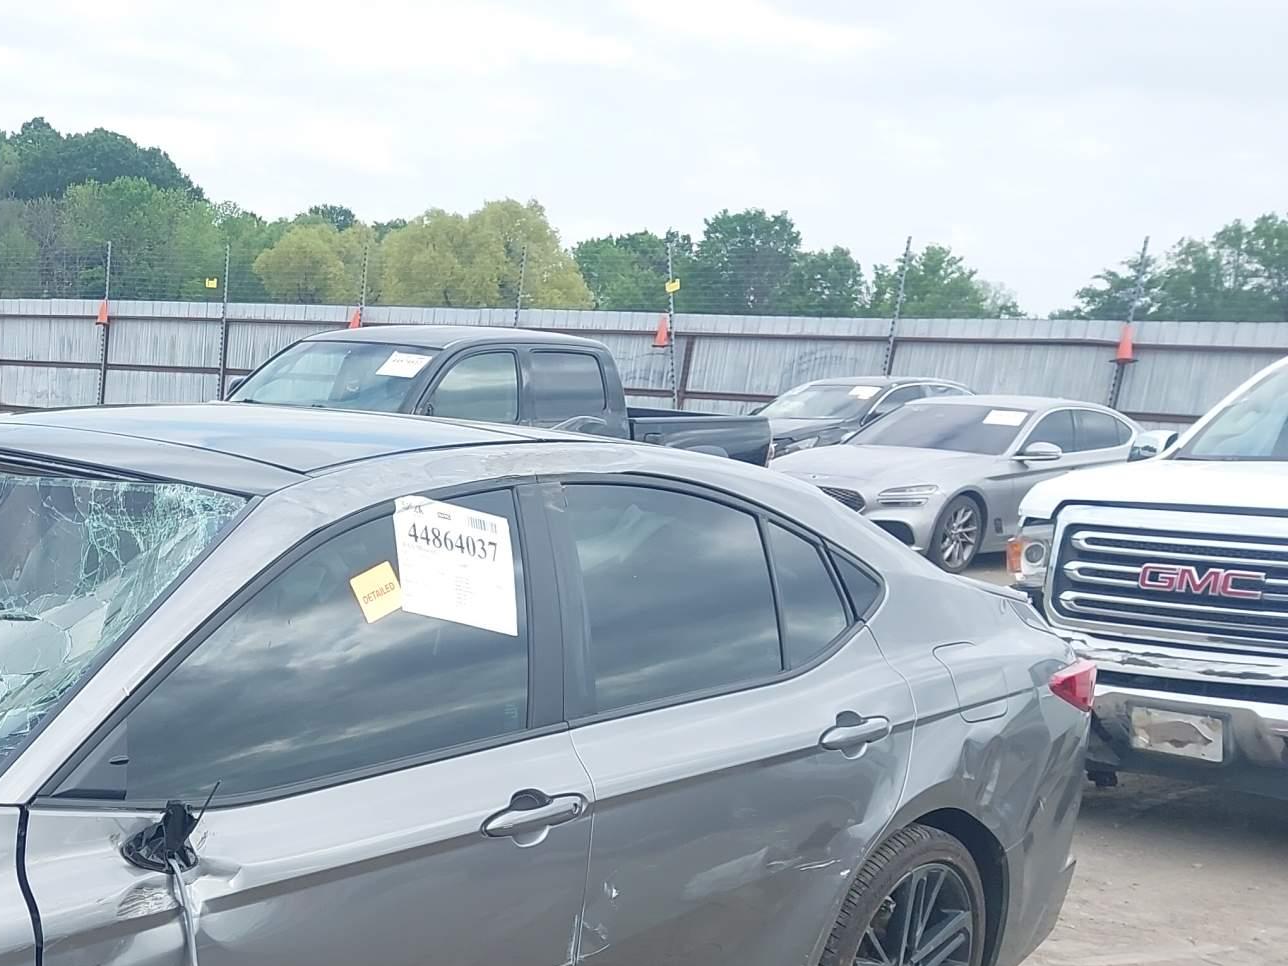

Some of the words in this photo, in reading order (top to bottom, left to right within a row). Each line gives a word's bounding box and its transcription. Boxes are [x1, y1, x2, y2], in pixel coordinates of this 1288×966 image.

[408, 522, 497, 562] 44864037
[362, 582, 396, 605] DETAILED
[1138, 562, 1266, 600] GMC
